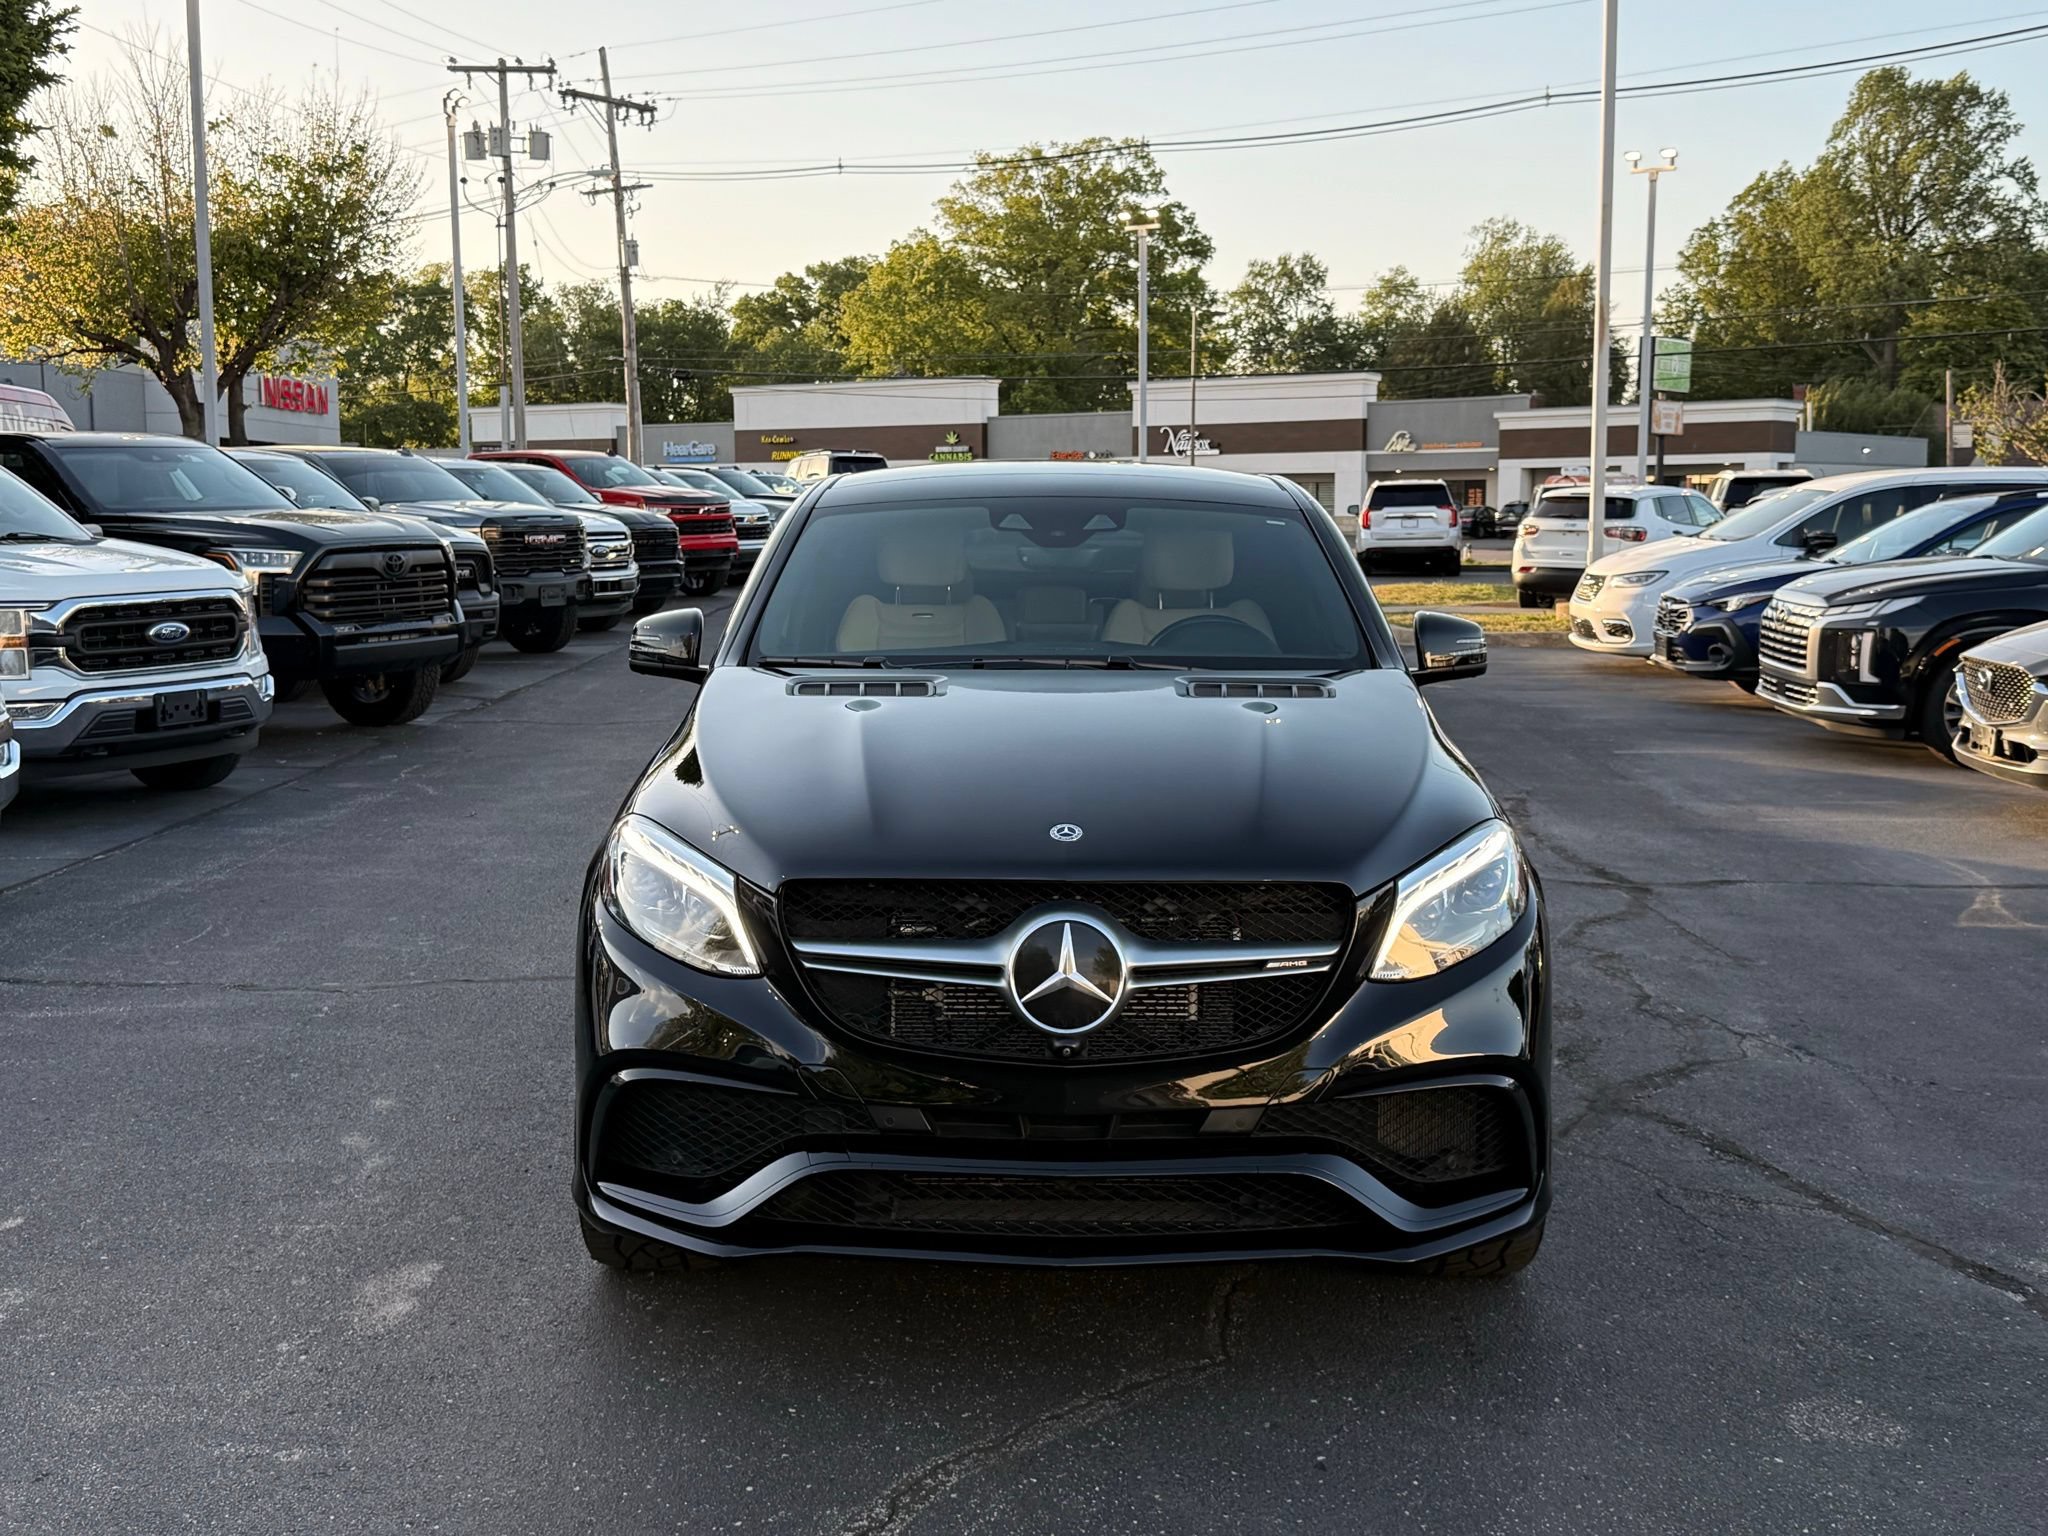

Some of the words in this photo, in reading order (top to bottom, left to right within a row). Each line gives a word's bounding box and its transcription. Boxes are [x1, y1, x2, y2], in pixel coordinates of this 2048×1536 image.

[259, 376, 329, 415] NISSAN
[663, 440, 716, 456] HearCare
[928, 452, 973, 463] CANNABIS
[528, 534, 567, 546] GMC
[160, 627, 181, 639] Ford
[1279, 960, 1308, 968] AMG
